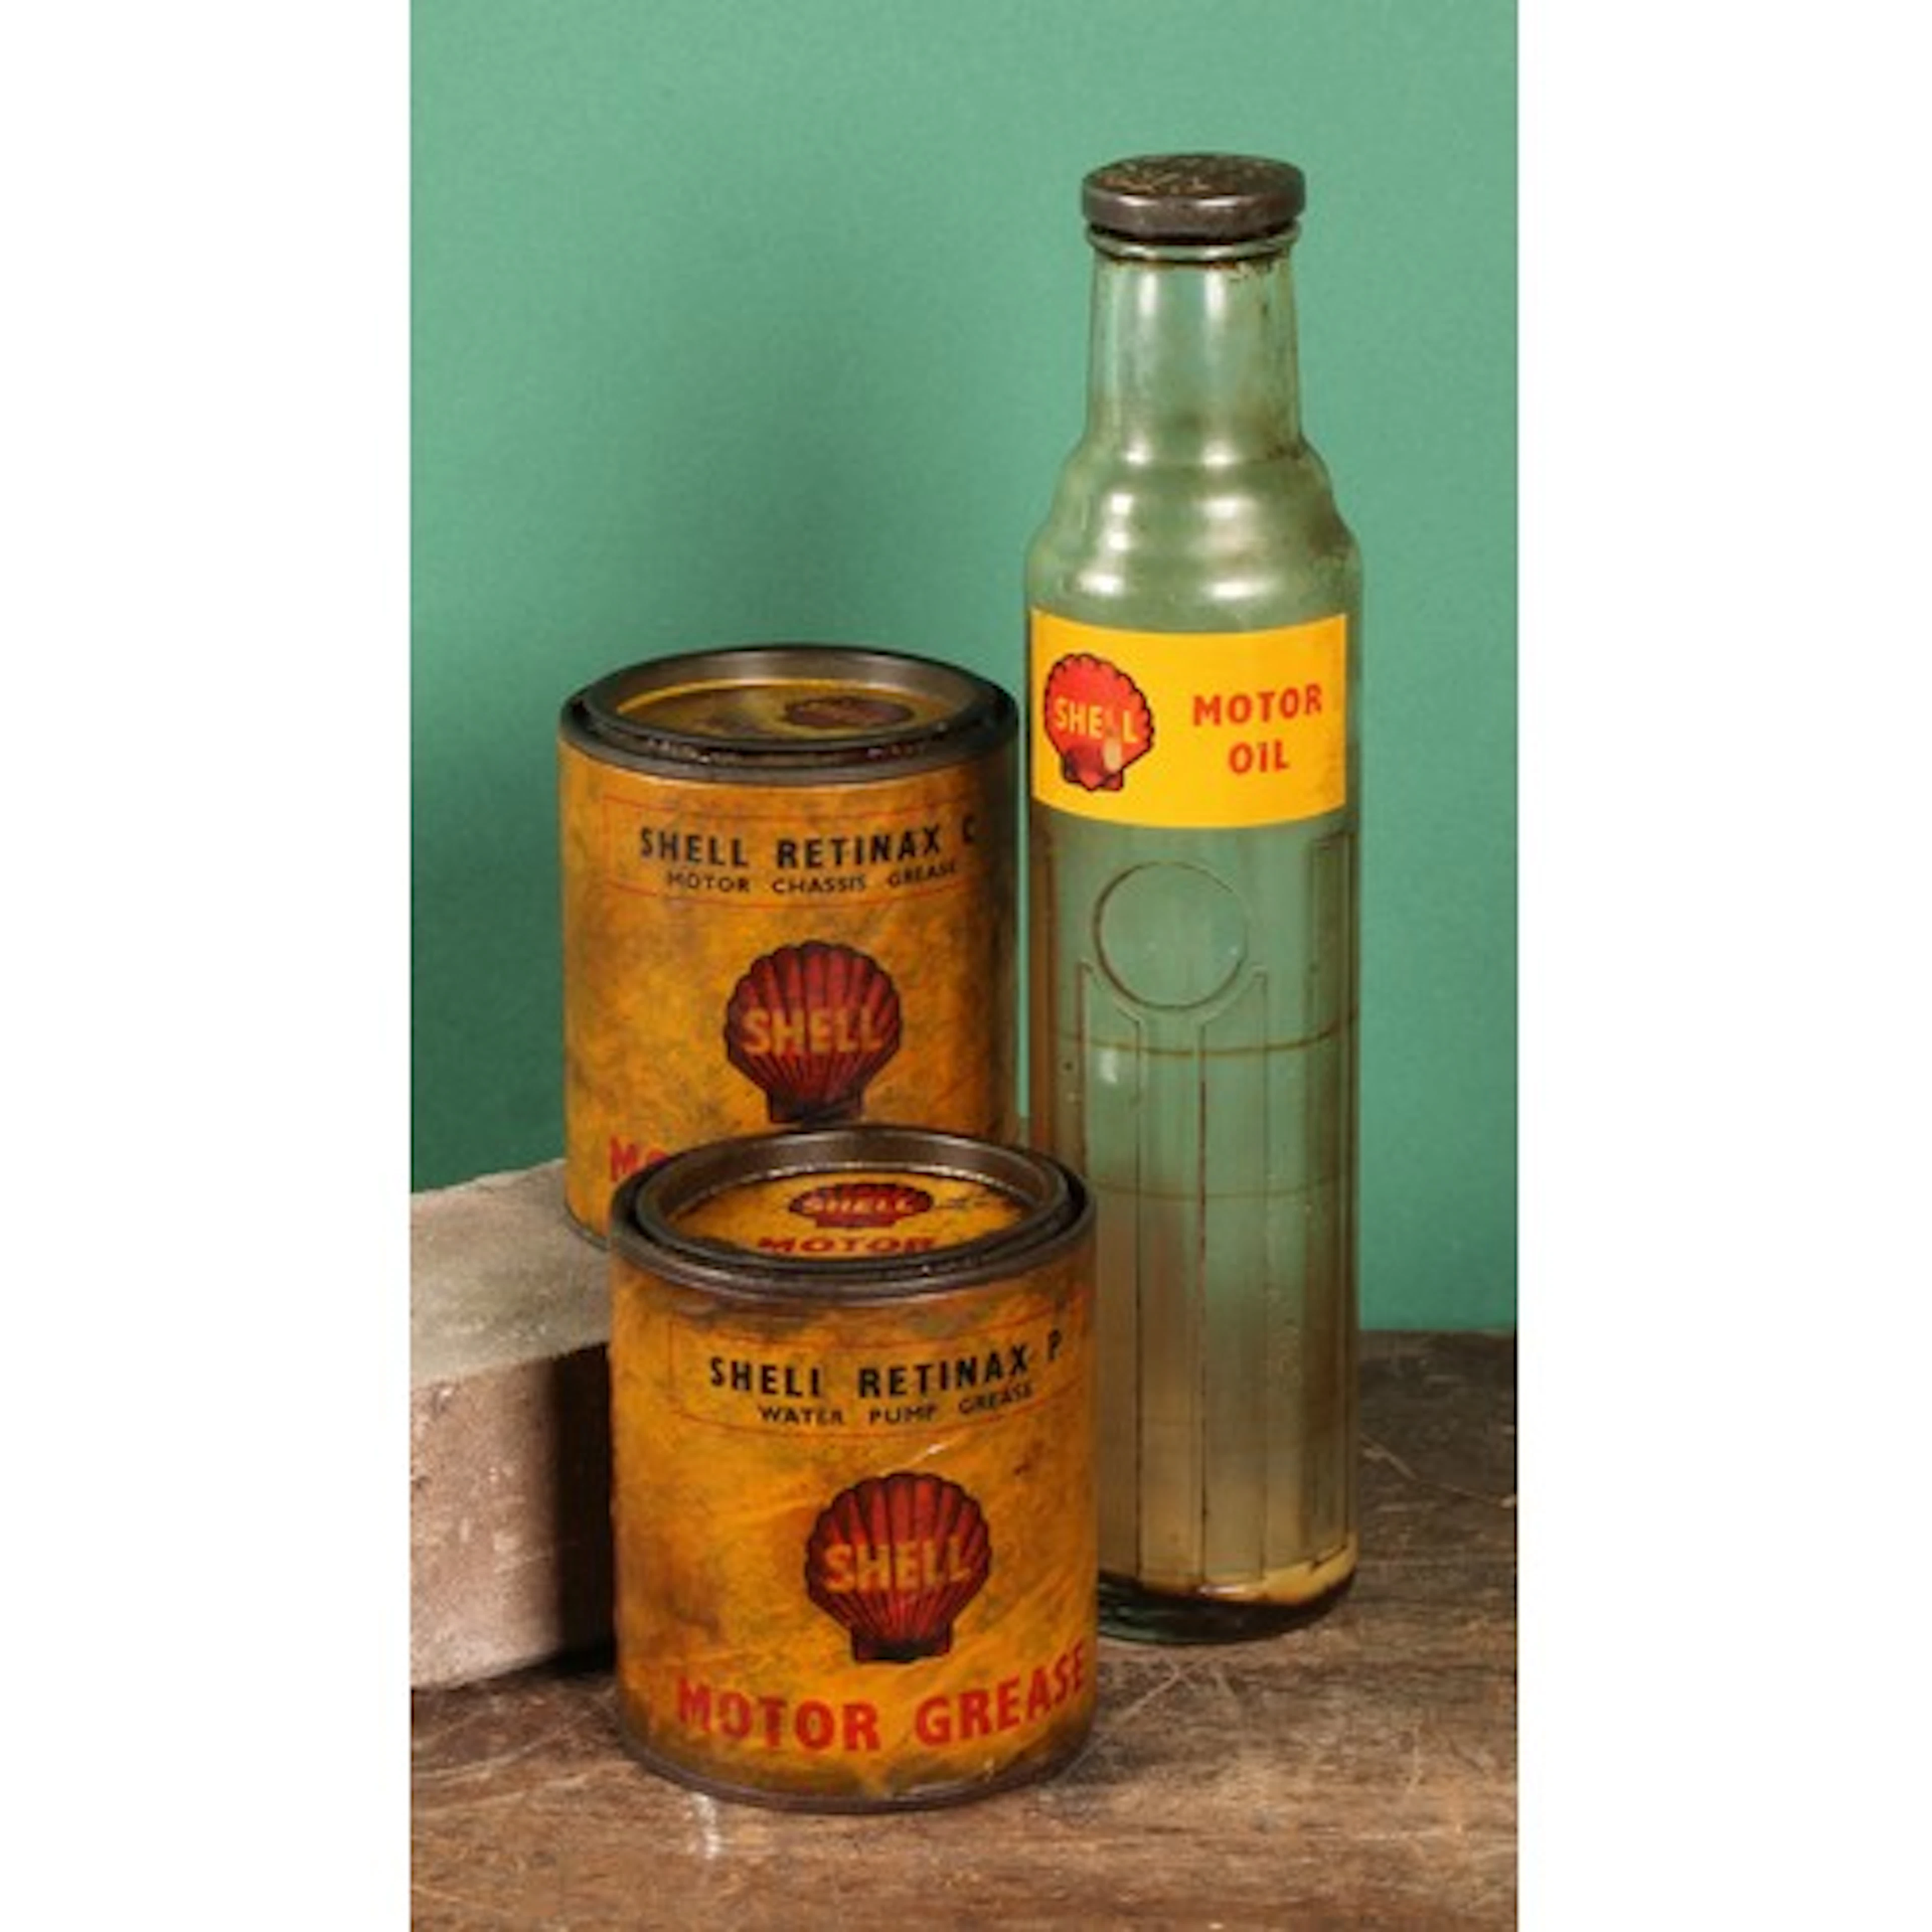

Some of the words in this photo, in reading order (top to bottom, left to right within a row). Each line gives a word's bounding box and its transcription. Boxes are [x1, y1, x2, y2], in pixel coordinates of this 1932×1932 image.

[1056, 697, 1139, 744] SHEL
[1193, 683, 1323, 726] MOTOR
[1228, 741, 1289, 774] OIL
[640, 827, 749, 867] SHELL
[777, 823, 941, 869] RETINAX
[667, 871, 750, 893] MOTOR
[772, 873, 865, 894] CHASSIS
[741, 1007, 886, 1055] SHELL
[858, 1343, 1028, 1398] RETINAX
[757, 1406, 844, 1425] WATER
[869, 1404, 938, 1425] PUMP
[825, 1536, 971, 1594] SHELL
[677, 1676, 880, 1752] MOTOR
[915, 1636, 1085, 1748] GREASE
